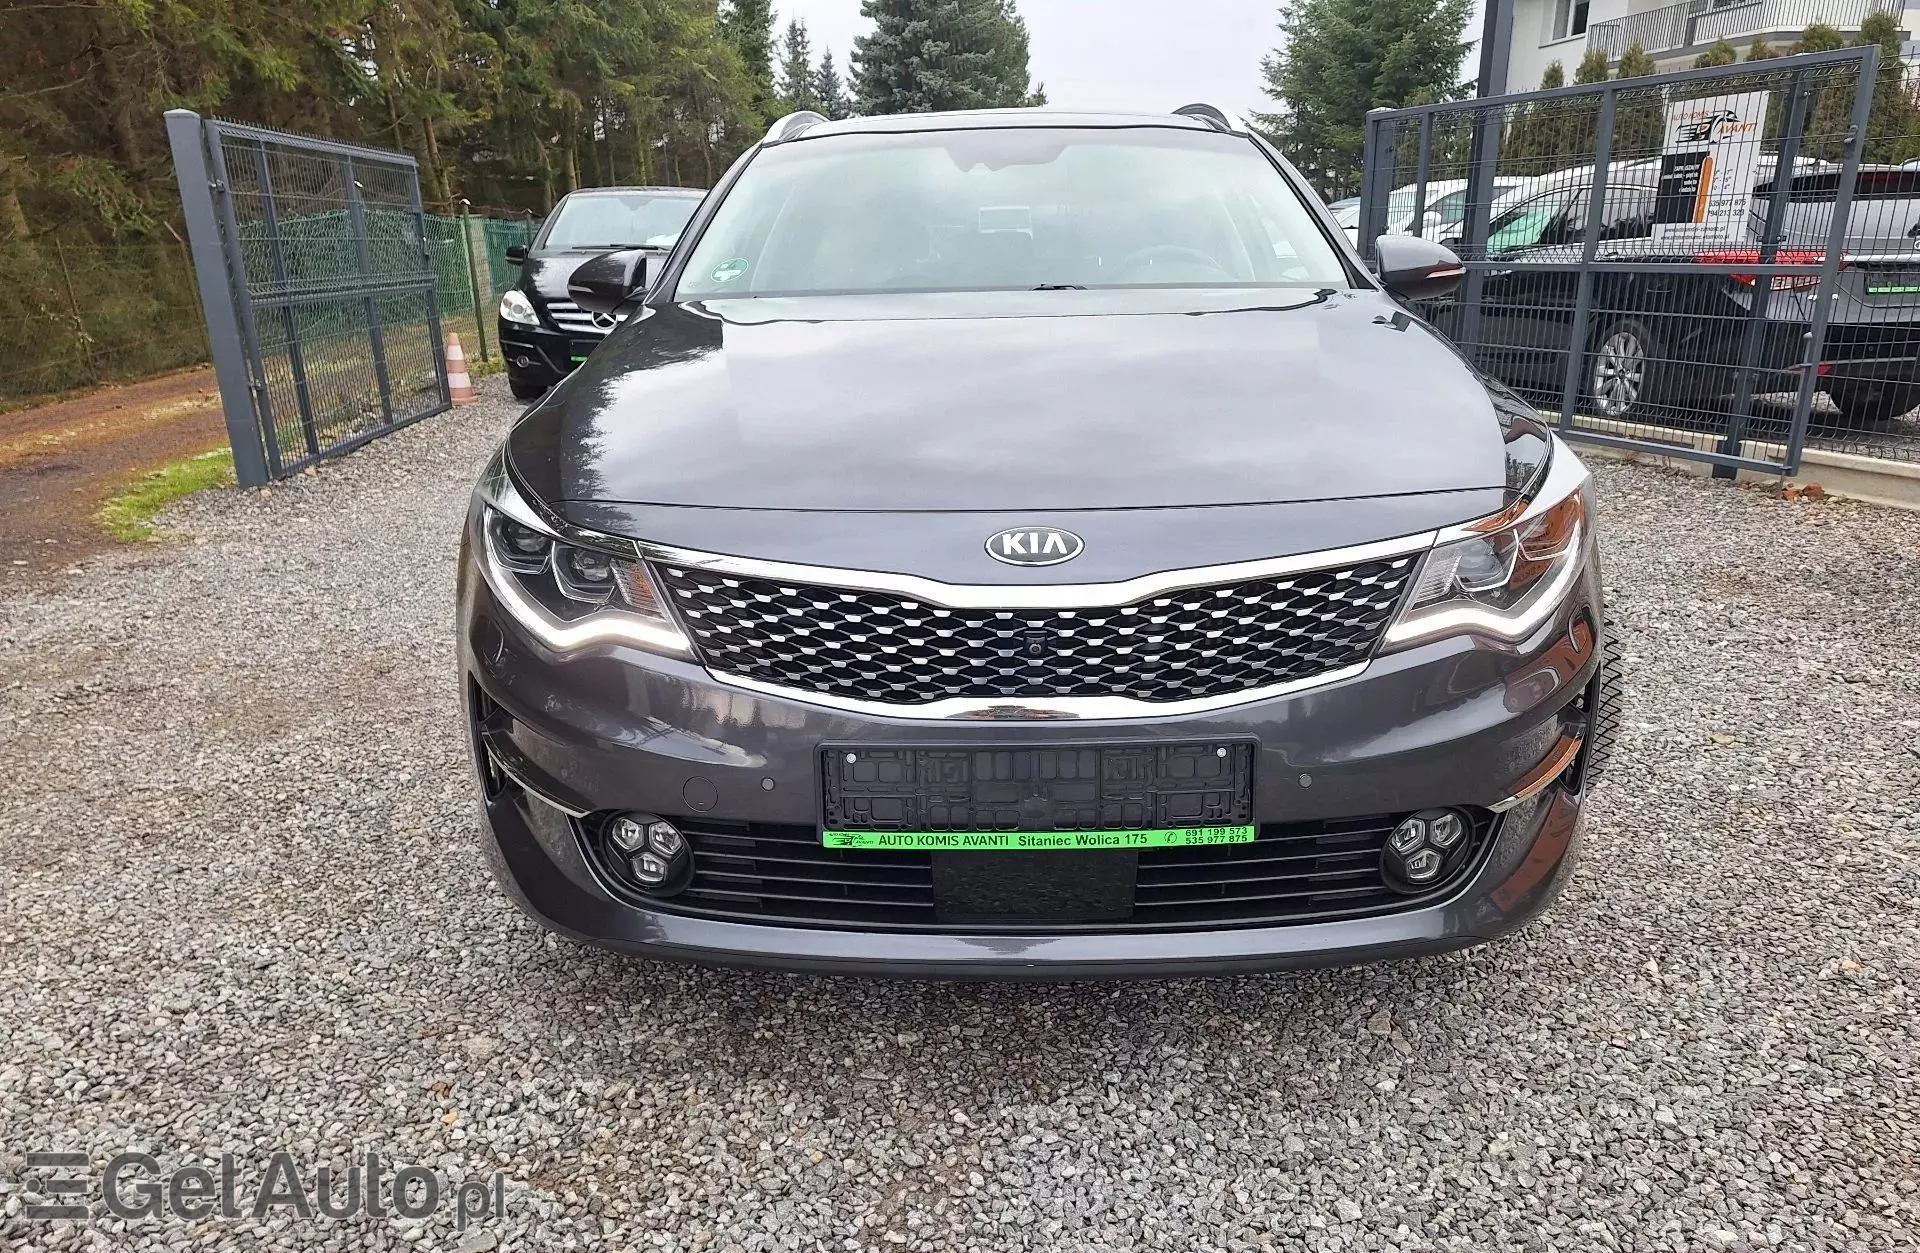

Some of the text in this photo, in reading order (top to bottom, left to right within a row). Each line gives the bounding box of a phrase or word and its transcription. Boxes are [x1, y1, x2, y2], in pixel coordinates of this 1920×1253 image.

[1717, 122, 1757, 134] AVANT
[1708, 209, 1718, 217] 94
[1001, 531, 1068, 555] KIA
[1185, 827, 1248, 837] 691 199 573
[878, 834, 1148, 847] AUTO KOMIS AVANTI Sitaniec Wolica 175
[1185, 835, 1248, 845] 535 977 875
